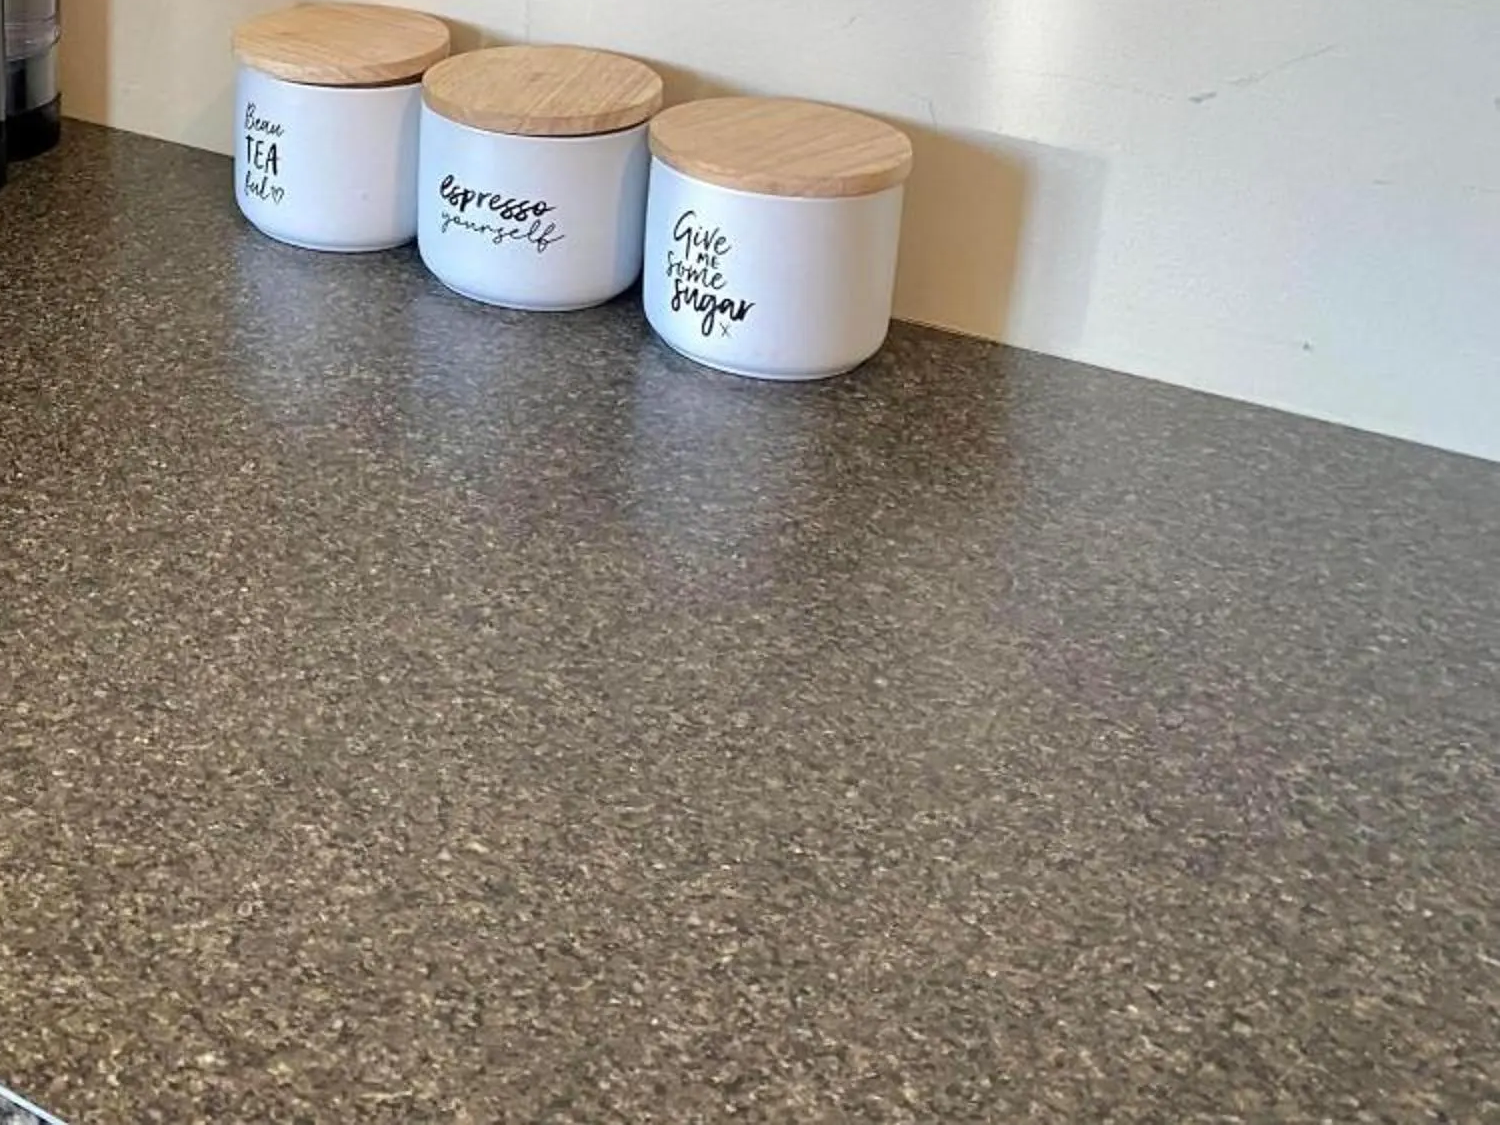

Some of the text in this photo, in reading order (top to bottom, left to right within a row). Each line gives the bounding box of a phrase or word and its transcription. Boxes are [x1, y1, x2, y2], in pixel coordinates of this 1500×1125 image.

[244, 100, 285, 138] Beau
[245, 134, 279, 177] TEA
[243, 169, 271, 201] ful
[439, 174, 557, 222] espresso
[440, 211, 566, 254] yourself
[672, 209, 733, 261] Give
[695, 251, 721, 270] ME
